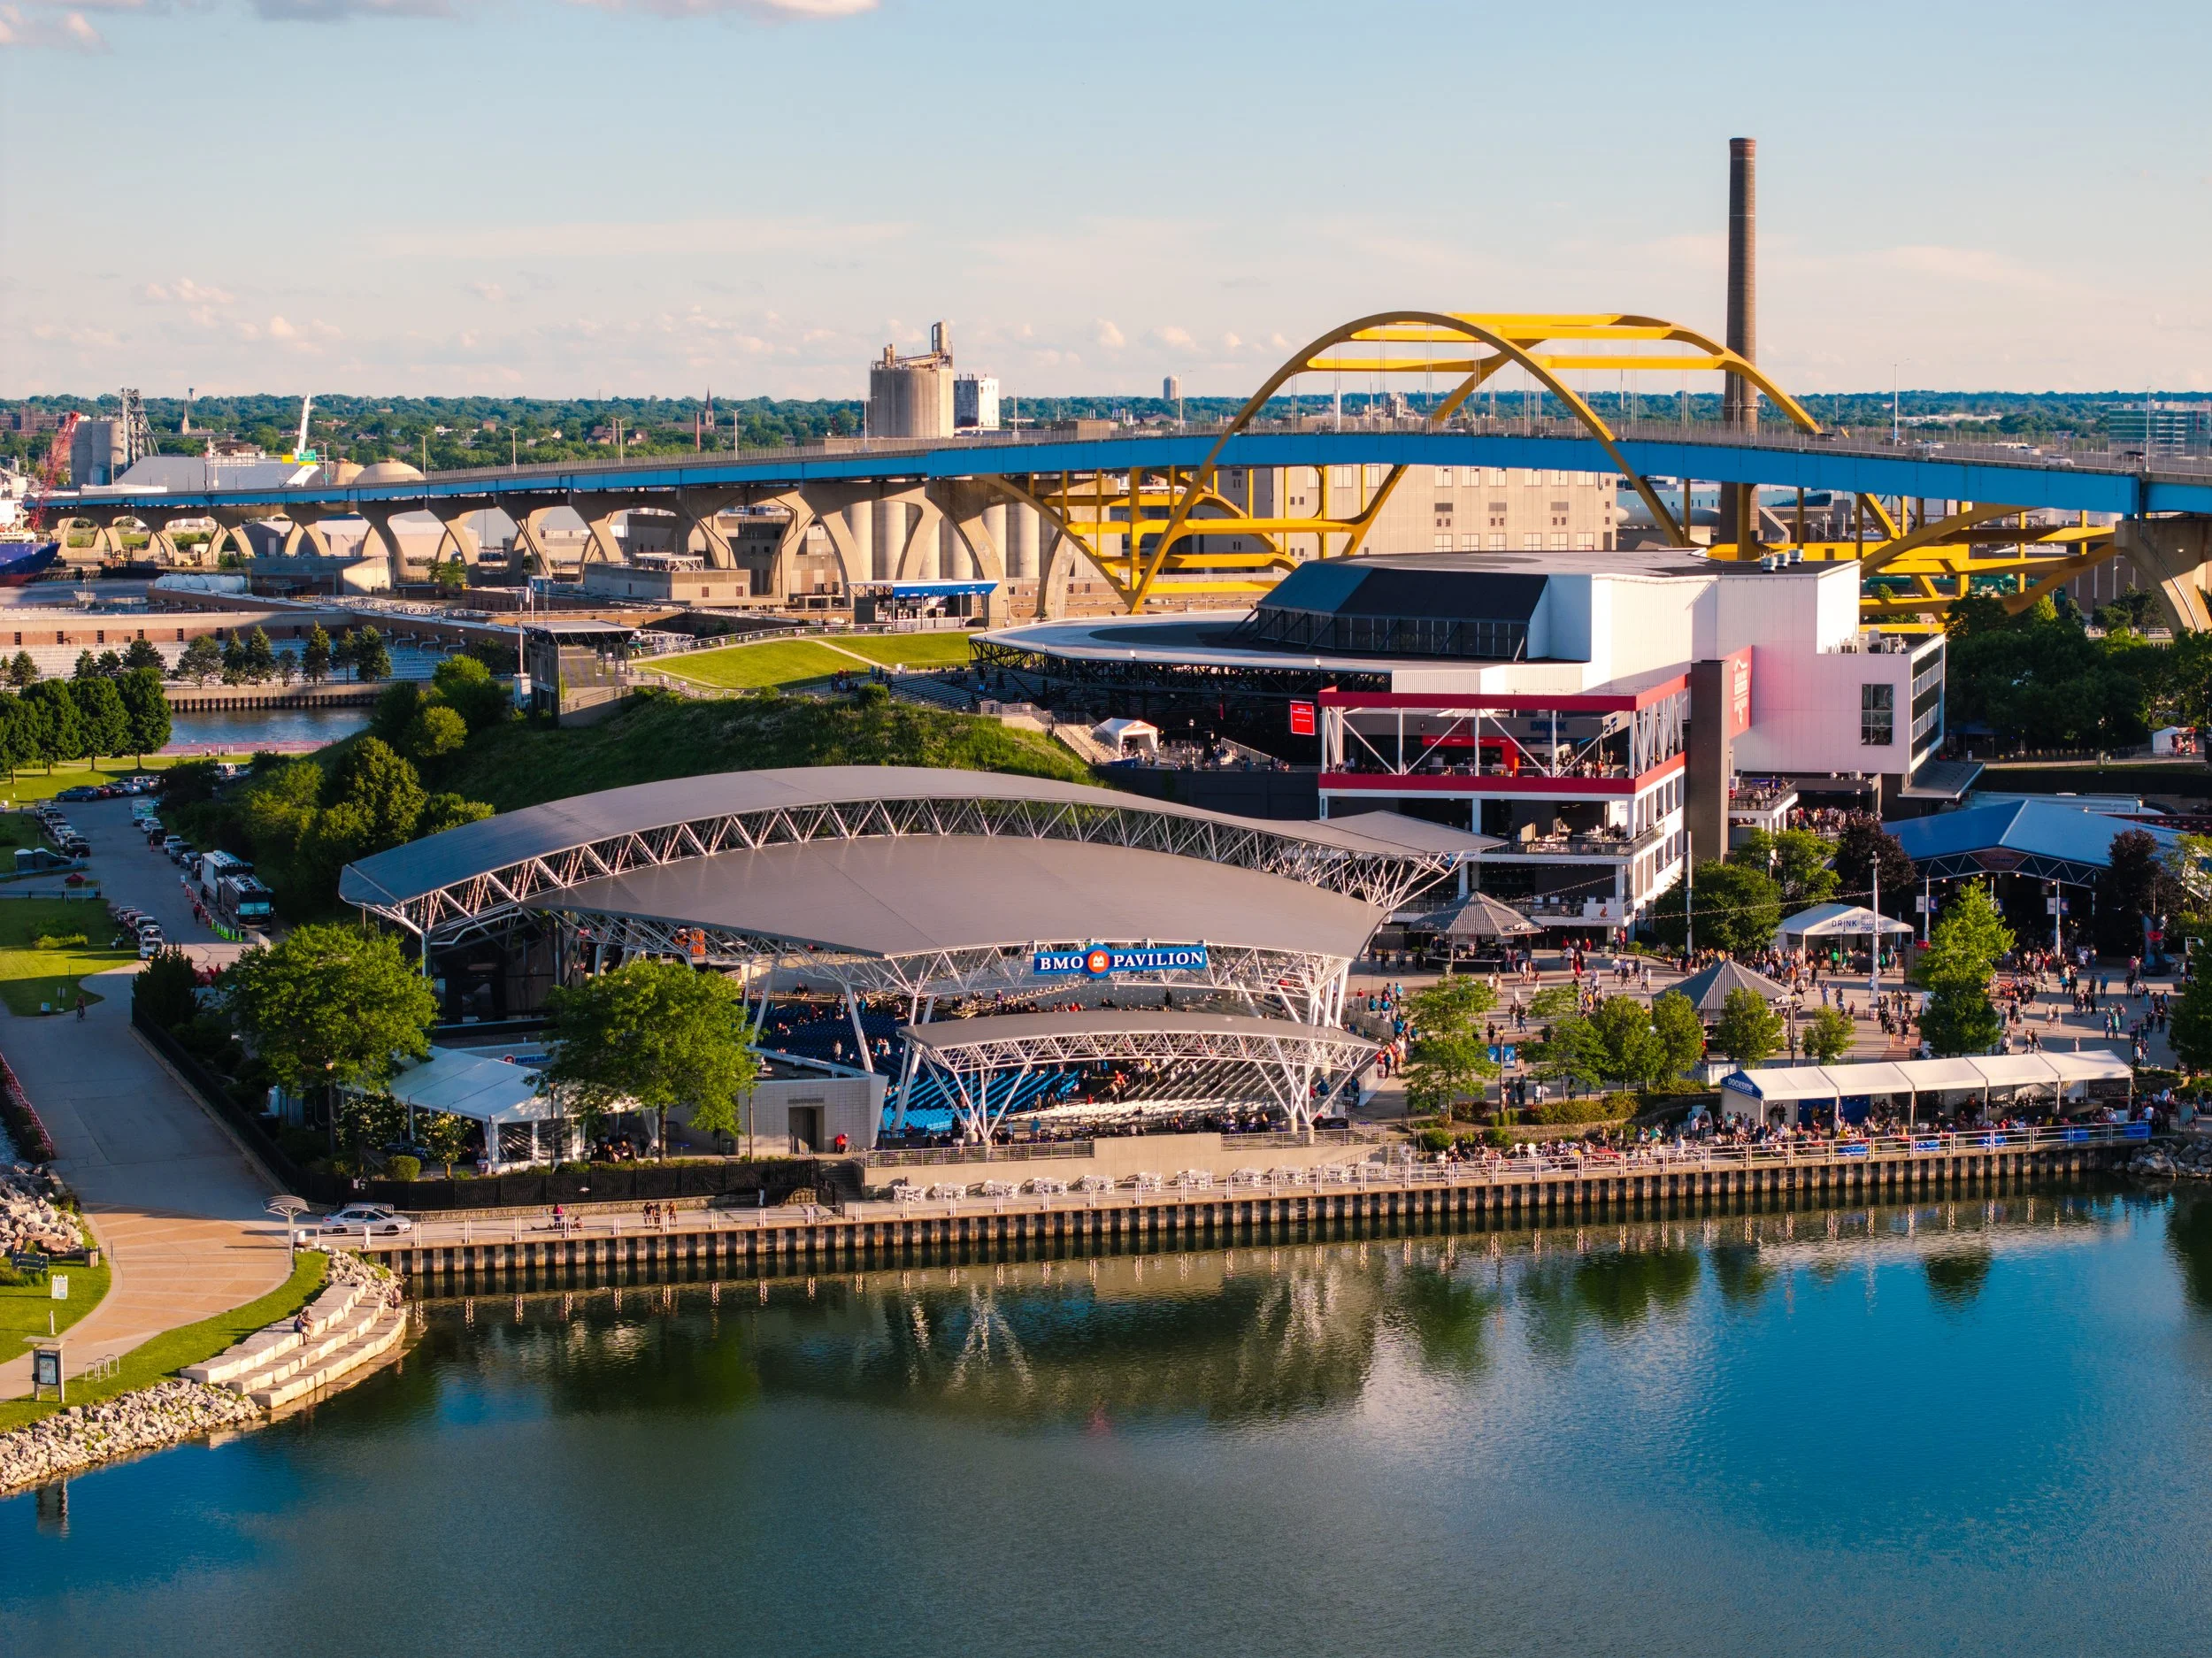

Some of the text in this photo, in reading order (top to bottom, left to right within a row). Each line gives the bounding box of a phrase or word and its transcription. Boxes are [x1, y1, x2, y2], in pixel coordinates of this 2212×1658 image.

[1832, 920, 1857, 932] DRINK
[1040, 951, 1203, 971] BMO PAVILION
[1728, 1078, 1753, 1093] DOCKSIDE
